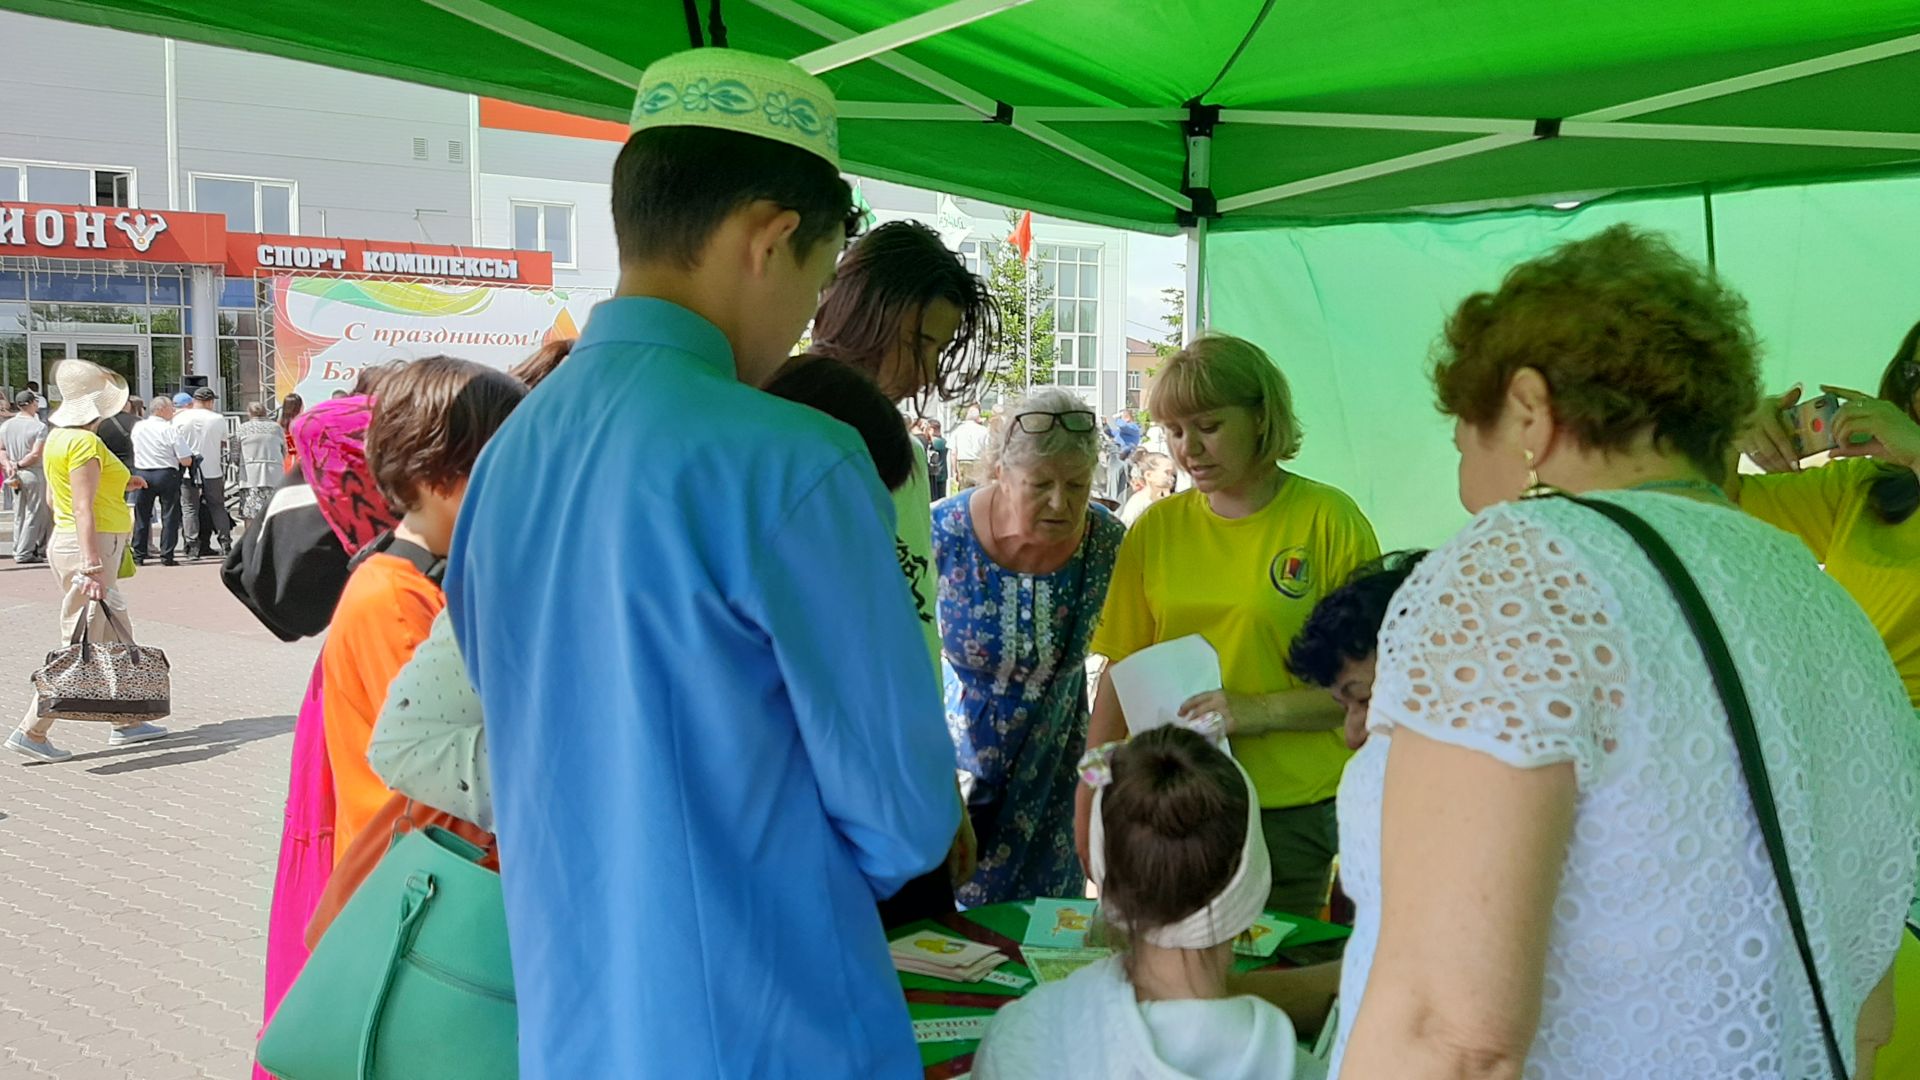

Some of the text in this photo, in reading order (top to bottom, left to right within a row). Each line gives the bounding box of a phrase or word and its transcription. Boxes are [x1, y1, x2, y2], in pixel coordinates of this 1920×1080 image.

[256, 244, 519, 279] СПОРТ КОМПЛЕКСЫ
[344, 322, 539, 346] С праздником!
